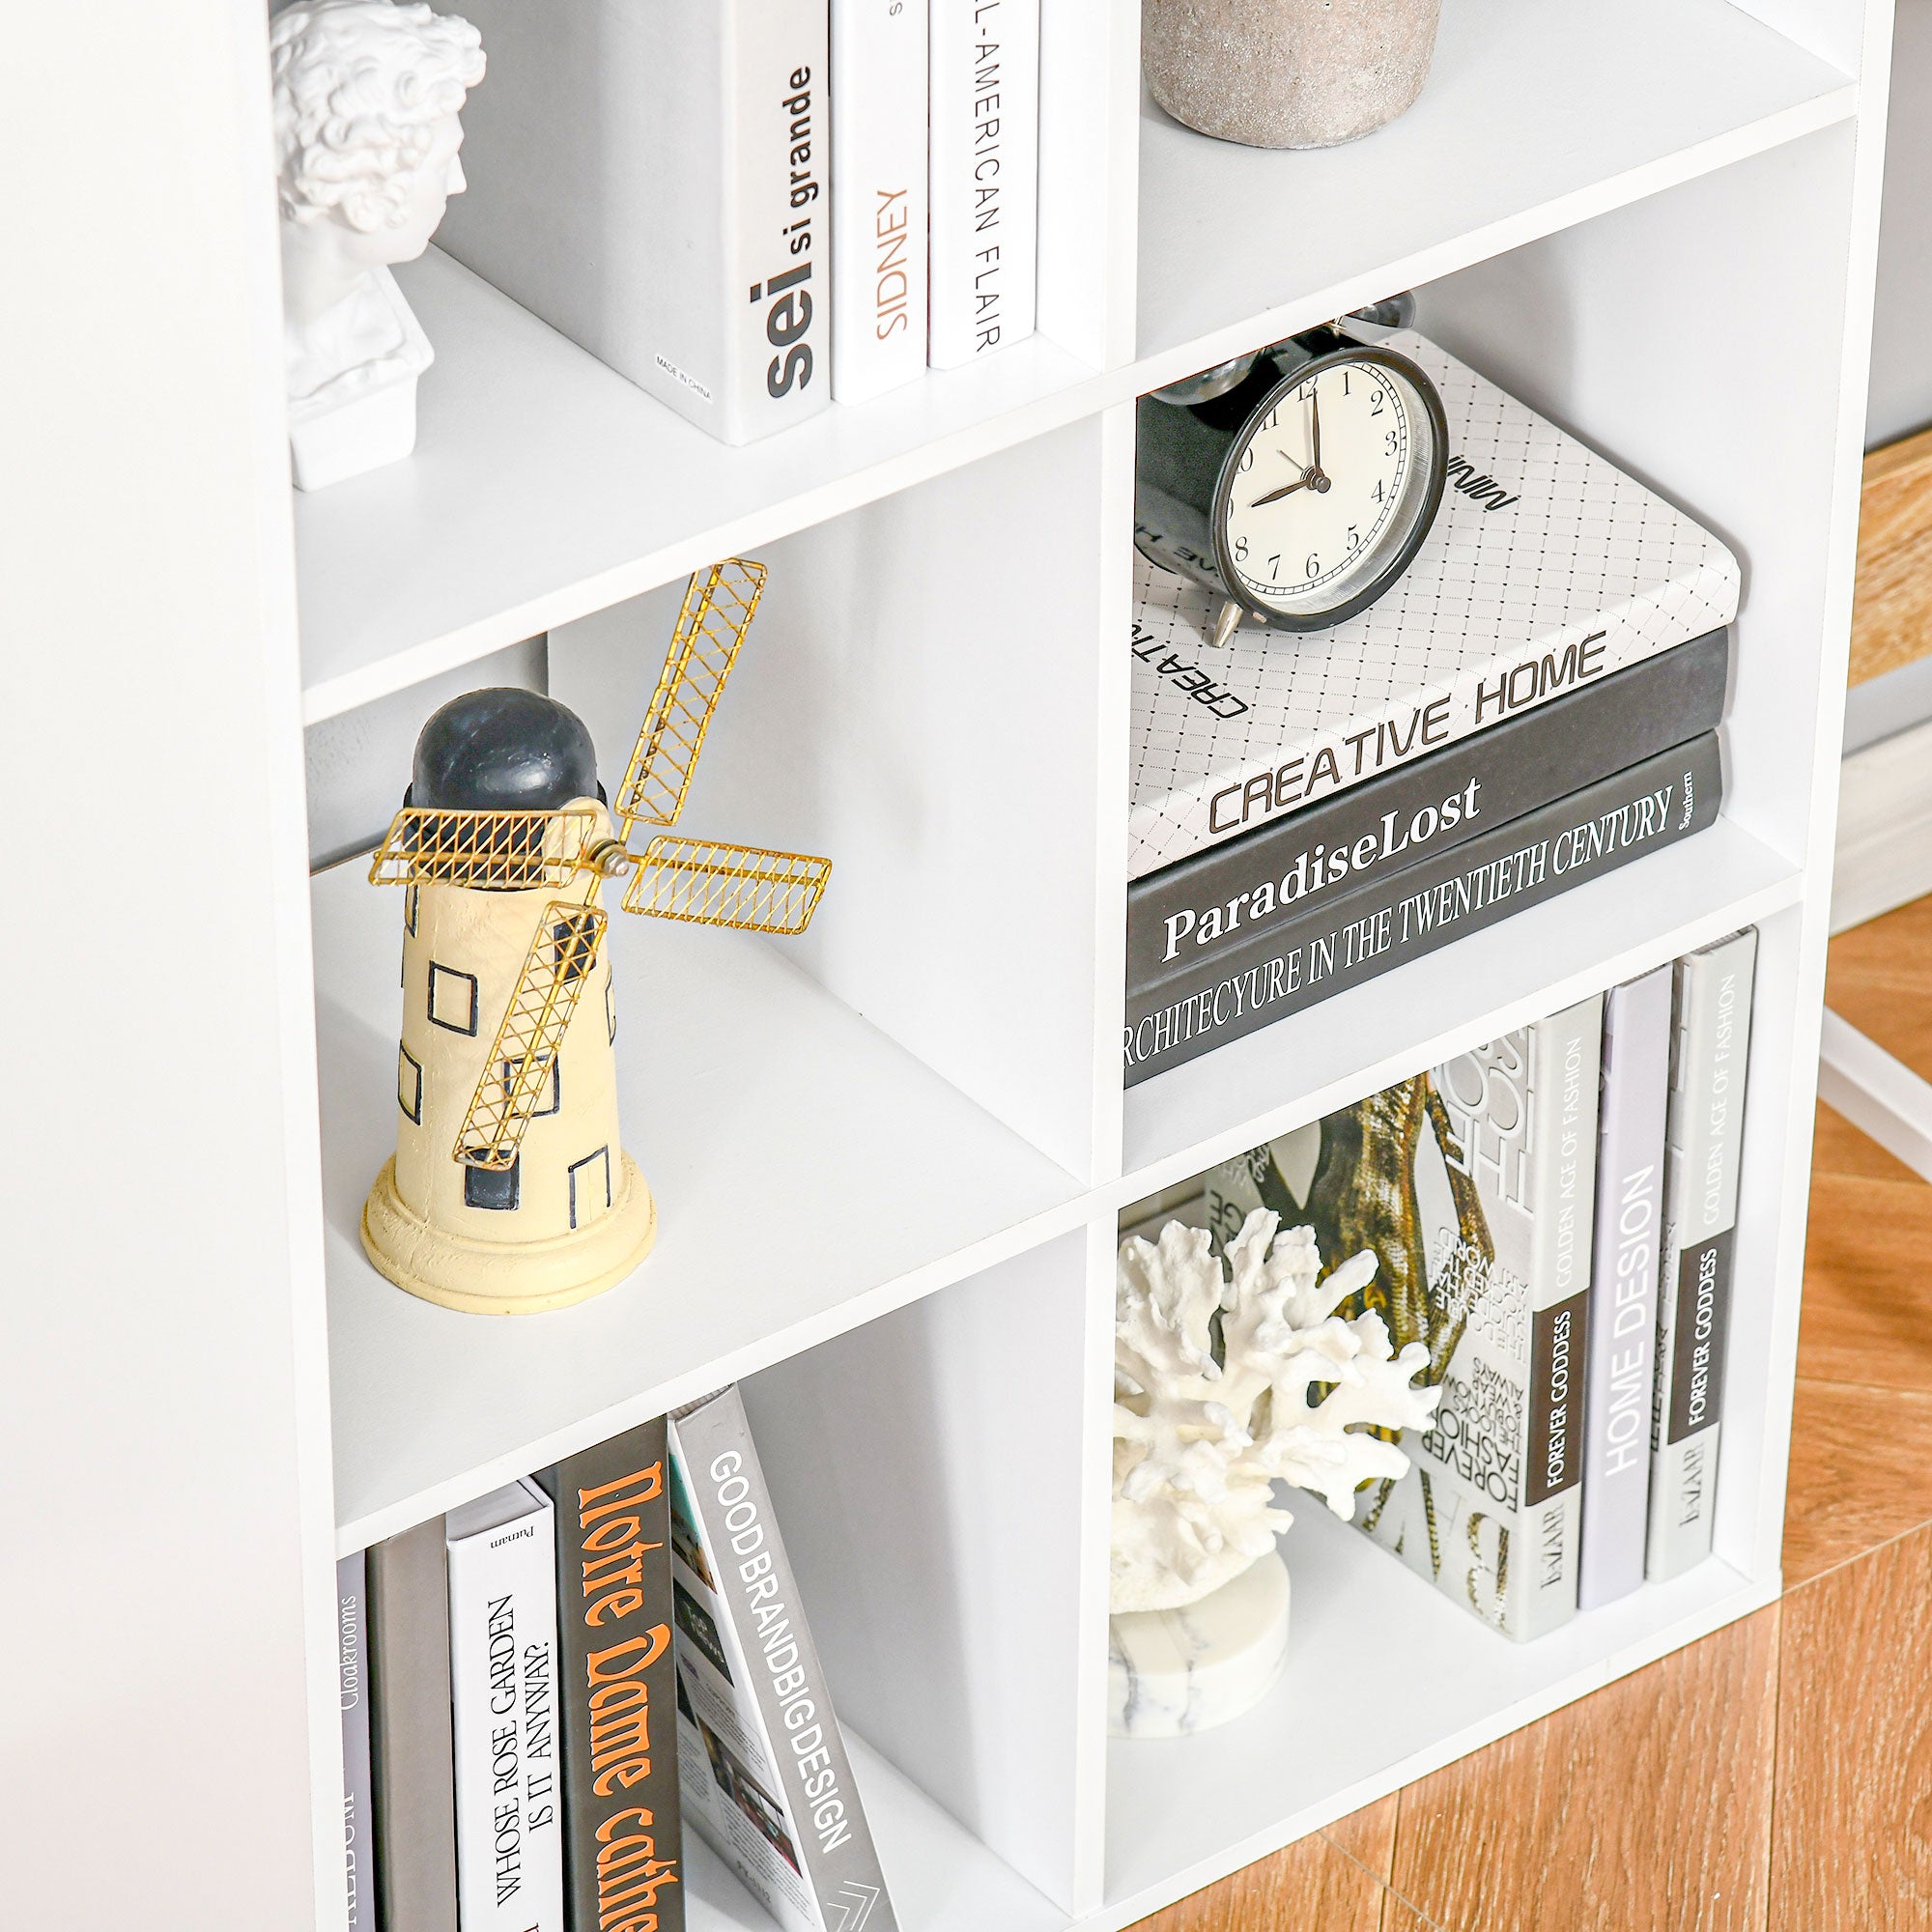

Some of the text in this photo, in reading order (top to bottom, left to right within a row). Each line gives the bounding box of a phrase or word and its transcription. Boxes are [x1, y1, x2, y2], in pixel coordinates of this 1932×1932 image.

[750, 65, 819, 400] sei si grande
[876, 187, 908, 340] SIDNEY
[975, 245, 1001, 353] FLAIR
[657, 356, 712, 401] MADE IN CHINA
[1296, 375, 1319, 403] 12
[1341, 371, 1352, 396] 1
[1370, 389, 1384, 416] 2
[1384, 431, 1398, 457] 3
[1447, 456, 1520, 511] MINI
[1370, 479, 1386, 504] 4
[1235, 536, 1249, 561] 8
[1266, 554, 1282, 581] 7
[1304, 553, 1321, 579] 6
[1346, 526, 1360, 551] 5
[1131, 623, 1249, 719] CREATI
[1208, 630, 1607, 835] CREATIVE HOME
[1677, 770, 1694, 831] Southern
[1161, 776, 1481, 964] ParadiseLost
[1307, 937, 1338, 987] IN
[1343, 912, 1393, 970] THE
[1399, 841, 1548, 944] TWENTIETH
[1552, 786, 1675, 876] CENTURY
[1703, 973, 1737, 1226] GOLDEN AGE OF FASHION
[1555, 1037, 1583, 1289] GOLDEN AGE OF FASHION
[1605, 1164, 1655, 1477] HOME DESIGN
[1688, 1247, 1718, 1427] FOREVER GODDESS
[1443, 1373, 1522, 1436] TO BUY NOW
[1472, 1356, 1524, 1401] ALWAYS
[1546, 1310, 1572, 1489] FOREVER GODDESS
[1453, 1395, 1522, 1455] THE LOOKS
[1421, 1430, 1519, 1514] FOREVER
[490, 1525, 535, 1549] Putnam
[340, 1594, 358, 1711] Cloakrooms
[487, 1594, 522, 1909] WHOSE ROSE GARDEN
[525, 1640, 554, 1834] IS IT ANYWAY?
[585, 1623, 672, 1799] Dame
